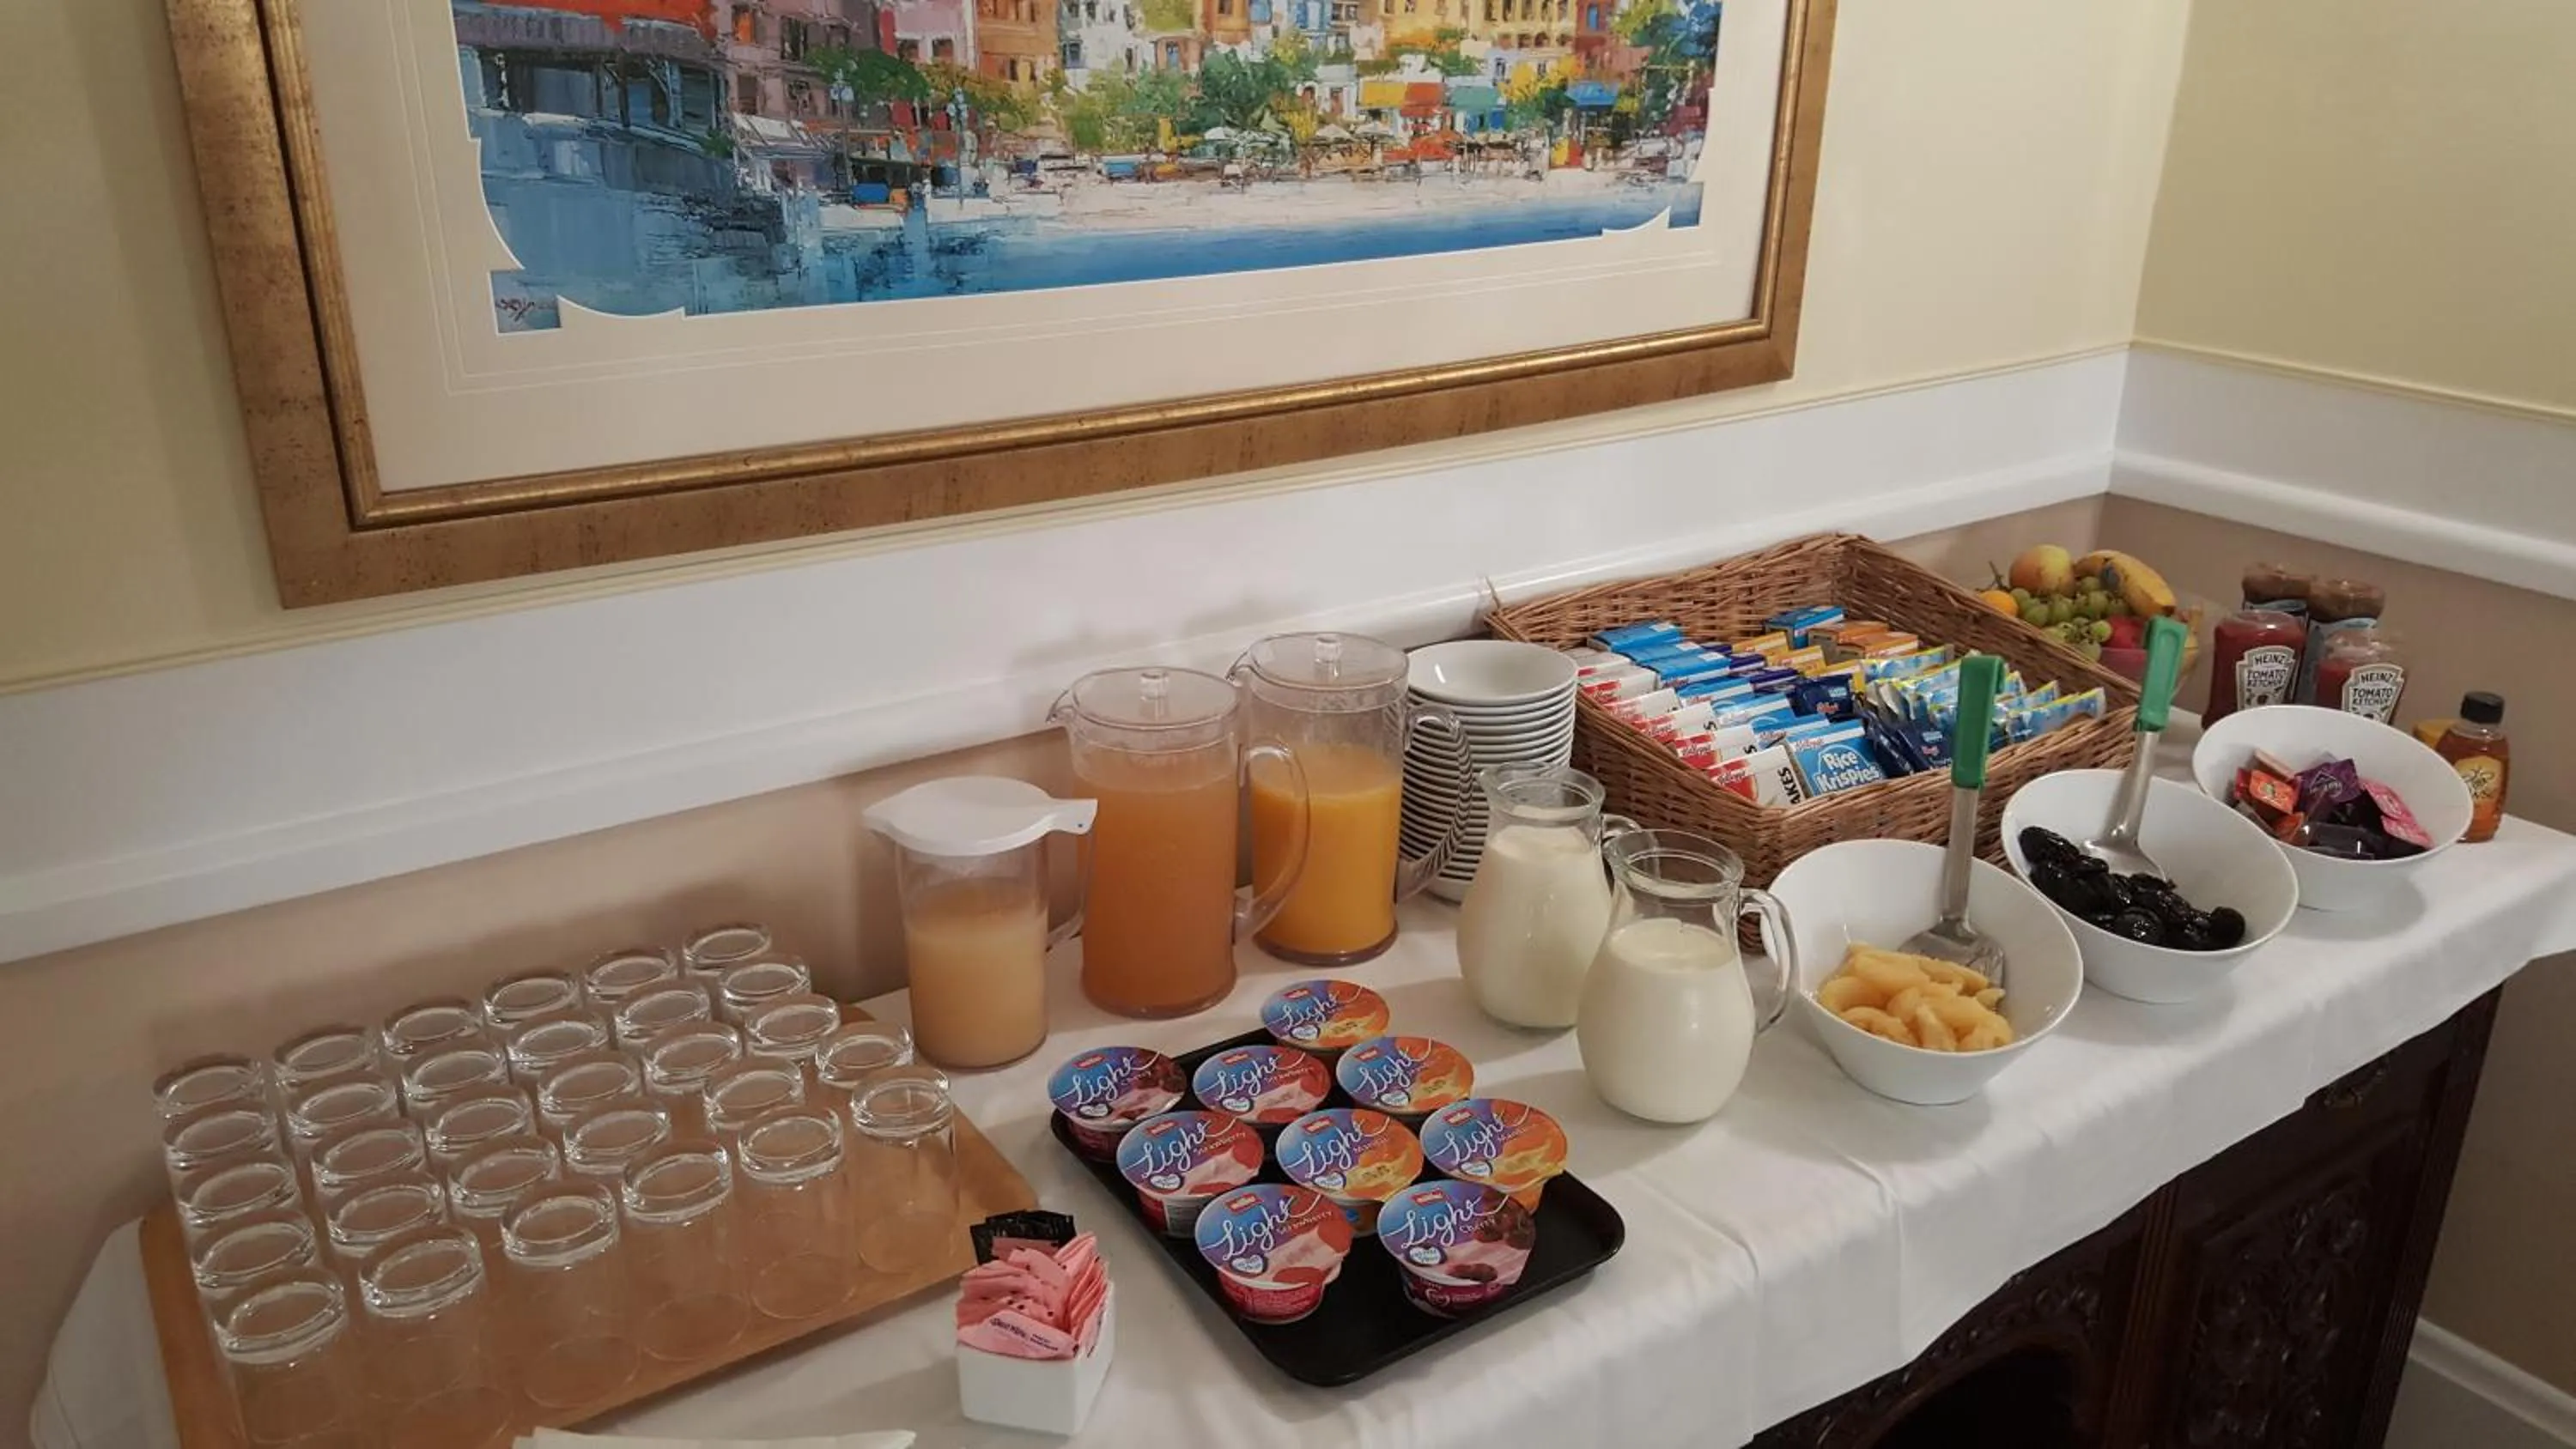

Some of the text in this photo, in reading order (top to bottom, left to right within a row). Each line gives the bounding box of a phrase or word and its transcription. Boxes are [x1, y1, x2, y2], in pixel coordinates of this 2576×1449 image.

[2247, 669, 2286, 680] TOMATO
[2254, 653, 2286, 665] HEINZ
[2360, 672, 2393, 683] HEINZ
[2353, 688, 2393, 698] TOMATO
[1815, 764, 1880, 793] Krispies
[1821, 751, 1859, 770] Rice
[1777, 767, 1802, 805] AKES
[1275, 988, 1351, 1030] Light
[1063, 1052, 1149, 1107] Light
[1205, 1052, 1294, 1100] Light
[1353, 1040, 1422, 1099] Light
[1133, 1119, 1224, 1178] Light
[1294, 1117, 1377, 1178] Light
[1436, 1106, 1517, 1164] Light
[1211, 1194, 1308, 1260] Light
[1391, 1196, 1496, 1249] Light
